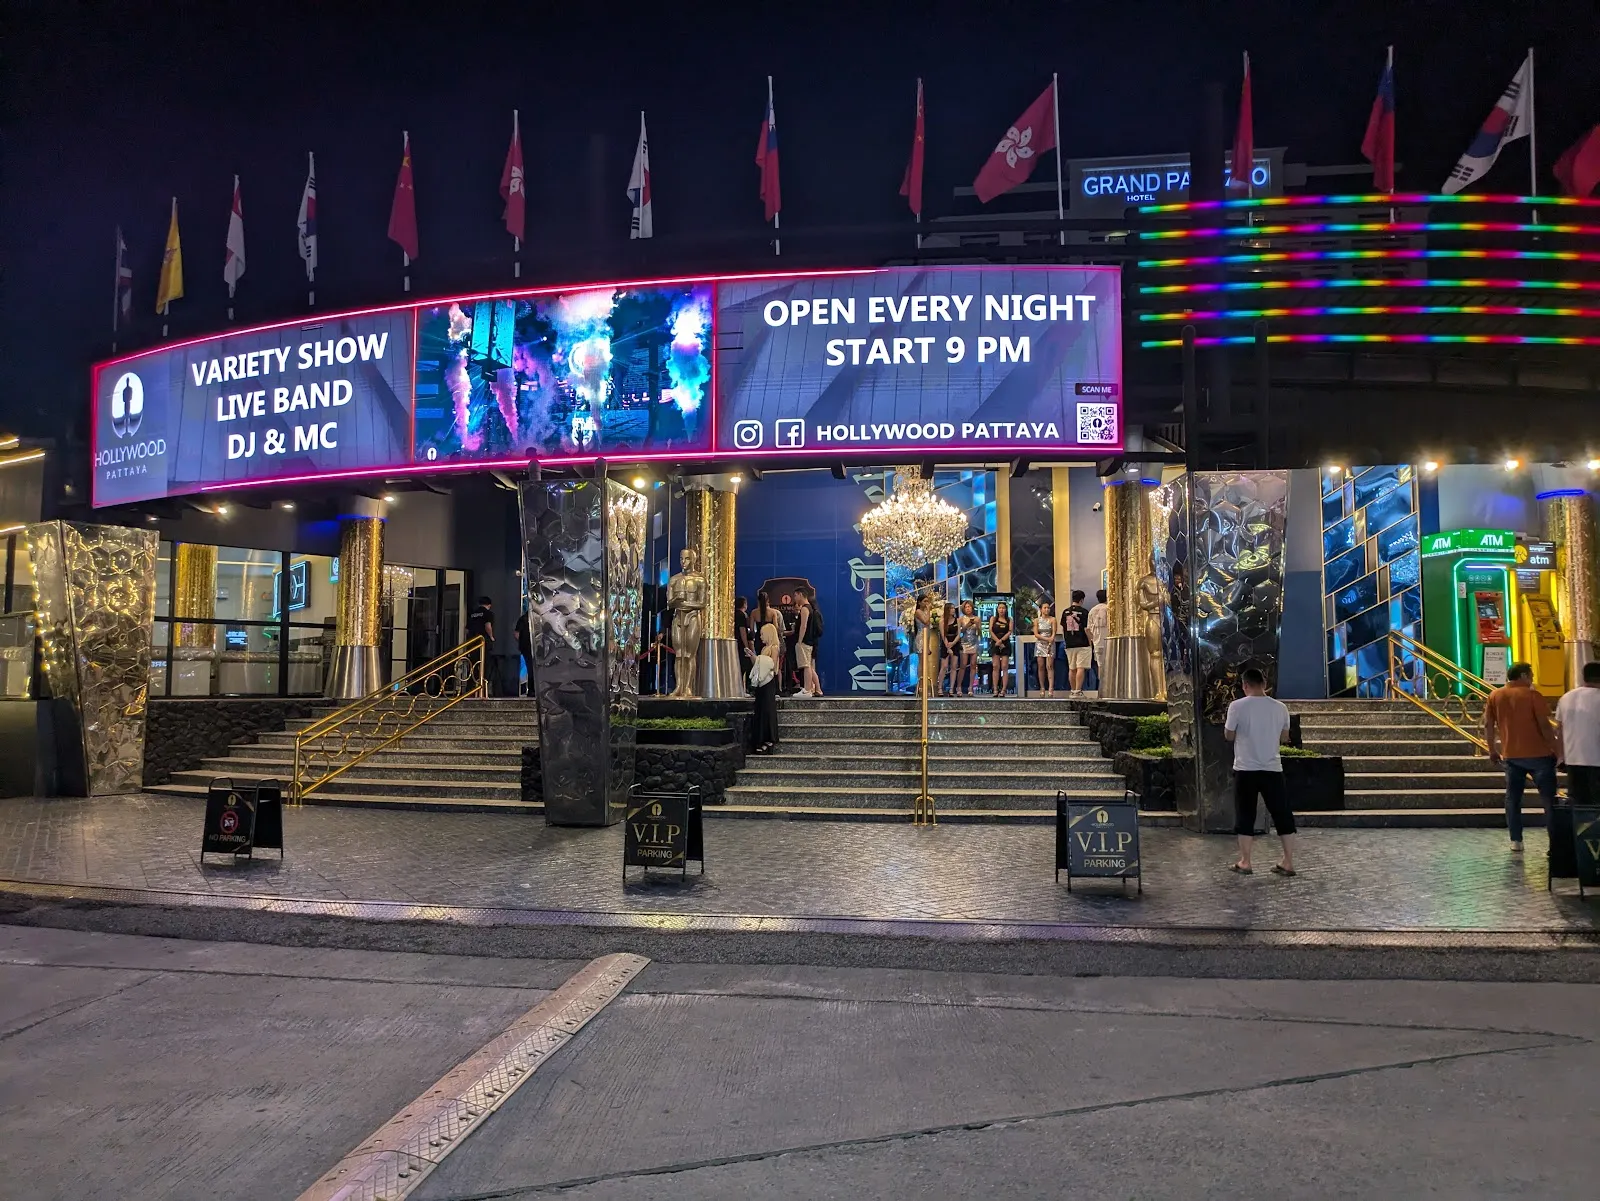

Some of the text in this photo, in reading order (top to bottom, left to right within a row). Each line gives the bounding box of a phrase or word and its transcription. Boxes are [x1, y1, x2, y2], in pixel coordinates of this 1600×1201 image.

[1084, 173, 1161, 196] GRAND
[1126, 194, 1155, 202] HOTEL
[763, 294, 1096, 327] OPEN EVERY NIGHT
[191, 332, 388, 387] VARIETY SHOW
[826, 336, 1031, 366] START 9 PM
[217, 379, 353, 422] LIVE BAND
[227, 422, 338, 460] DJ & MC
[817, 422, 1060, 441] HOLLYWOOD PATTAYA
[94, 438, 167, 468] HOLLYWOOD
[106, 464, 147, 480] PATTAYA
[1432, 536, 1451, 550] ATM
[1480, 534, 1503, 546] ATM
[1530, 555, 1550, 564] atm
[220, 834, 246, 842] PARKING
[632, 823, 680, 843] V.I.P
[1075, 832, 1132, 852] V.I.P
[637, 849, 672, 858] PARKING
[1084, 859, 1125, 868] PARKING
